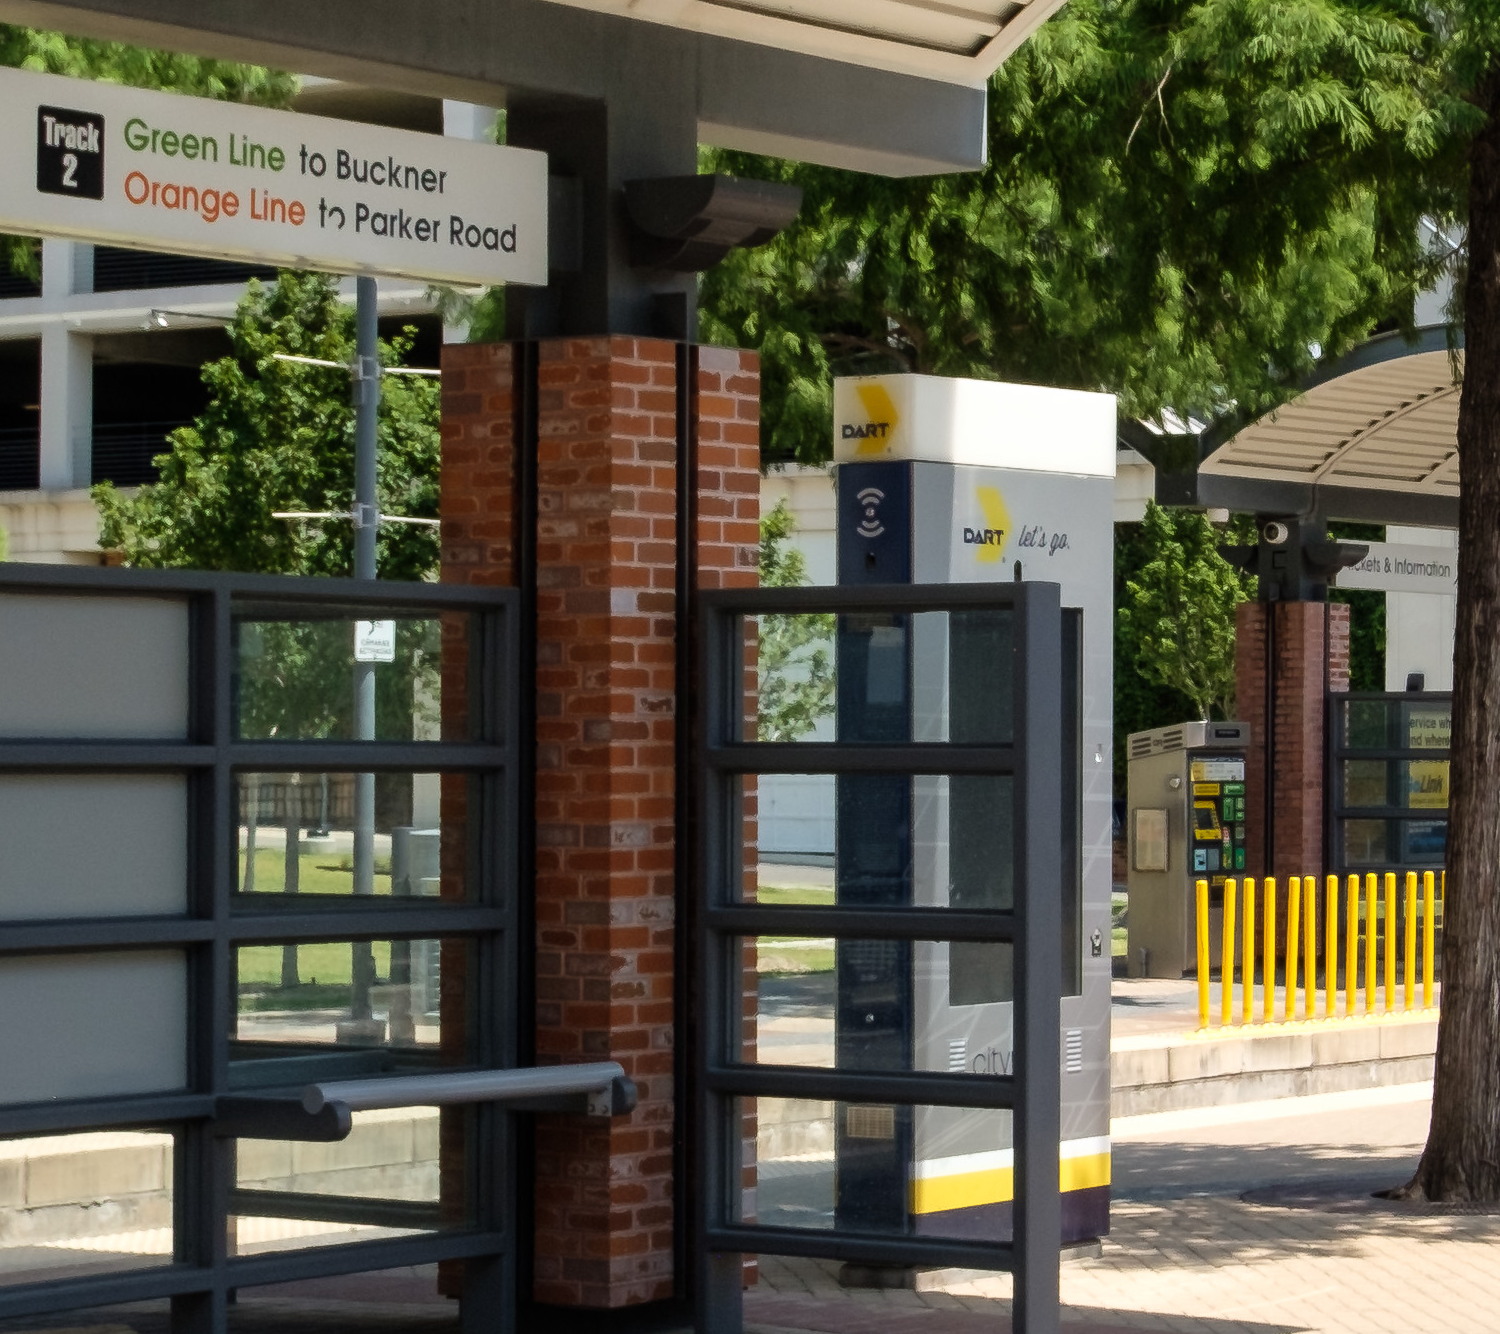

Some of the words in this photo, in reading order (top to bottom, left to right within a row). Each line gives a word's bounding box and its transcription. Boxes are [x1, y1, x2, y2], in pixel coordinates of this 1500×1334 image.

[42, 115, 100, 154] Track
[62, 153, 78, 188] 2
[124, 117, 218, 163] Green
[229, 132, 286, 172] Line
[299, 143, 327, 177] to
[336, 148, 448, 194] Buckner
[124, 170, 240, 223] Orange
[250, 187, 306, 226] Line
[318, 196, 346, 230] to
[355, 201, 441, 243] Parker
[450, 214, 517, 253] Road
[841, 422, 890, 440] DART
[963, 527, 1005, 546] DART
[1018, 524, 1048, 549] let's
[1383, 556, 1392, 574] &
[1394, 557, 1451, 578] Information
